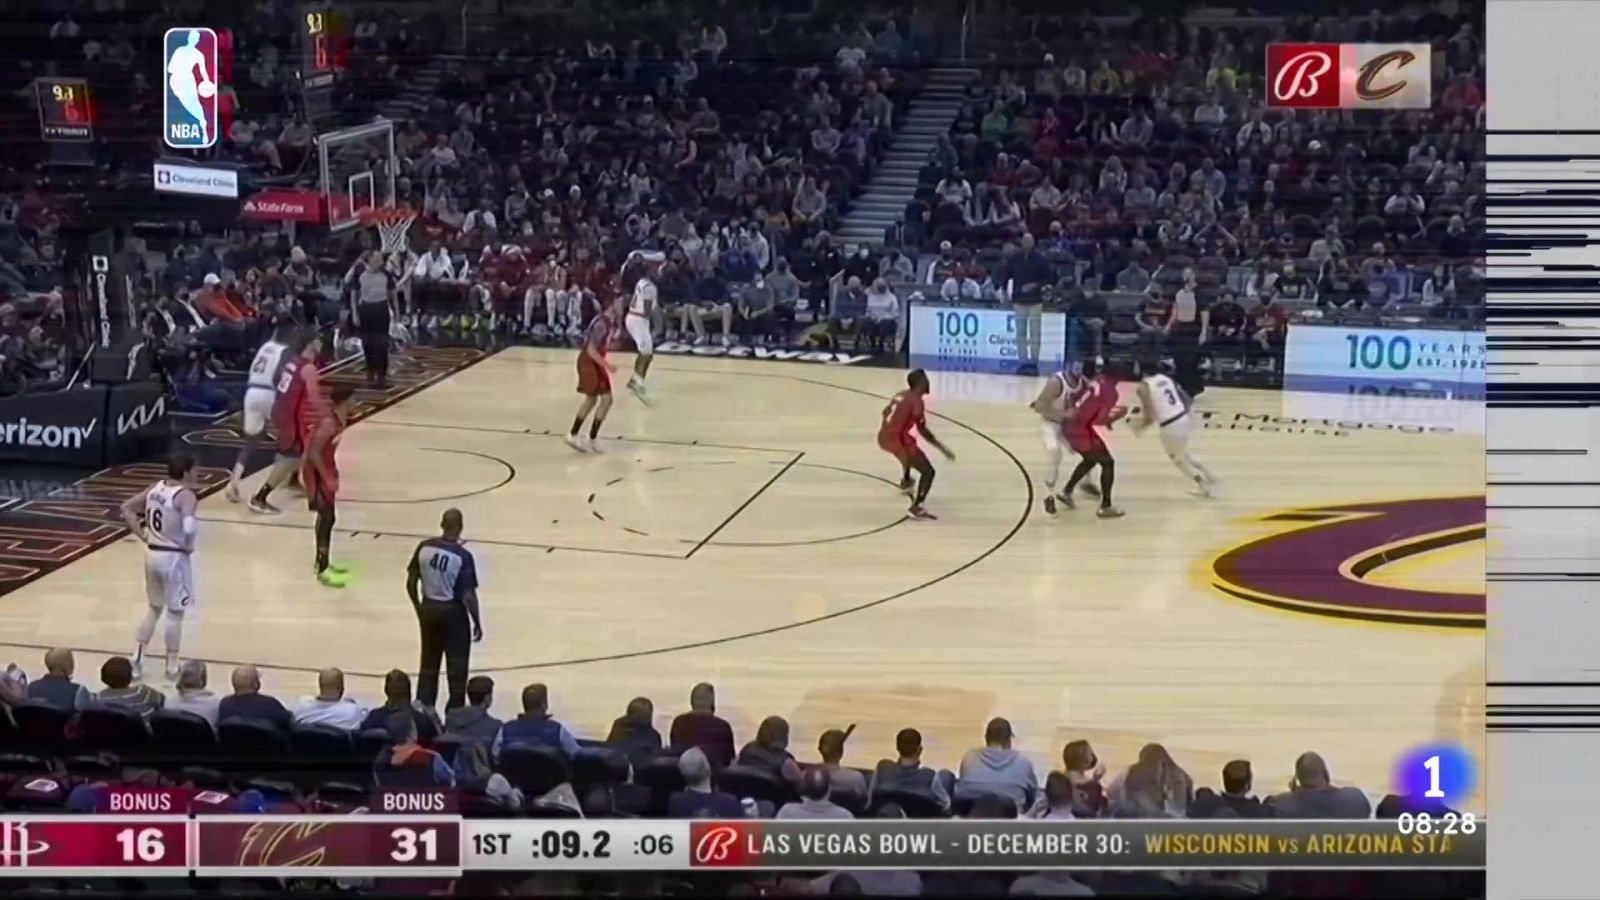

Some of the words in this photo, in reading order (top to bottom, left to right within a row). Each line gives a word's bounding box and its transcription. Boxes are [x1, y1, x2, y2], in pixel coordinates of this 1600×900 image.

[936, 311, 979, 337] 100
[1346, 334, 1412, 371] 100
[1418, 342, 1486, 355] YEARS
[1164, 388, 1177, 406] 3
[429, 552, 450, 573] 40
